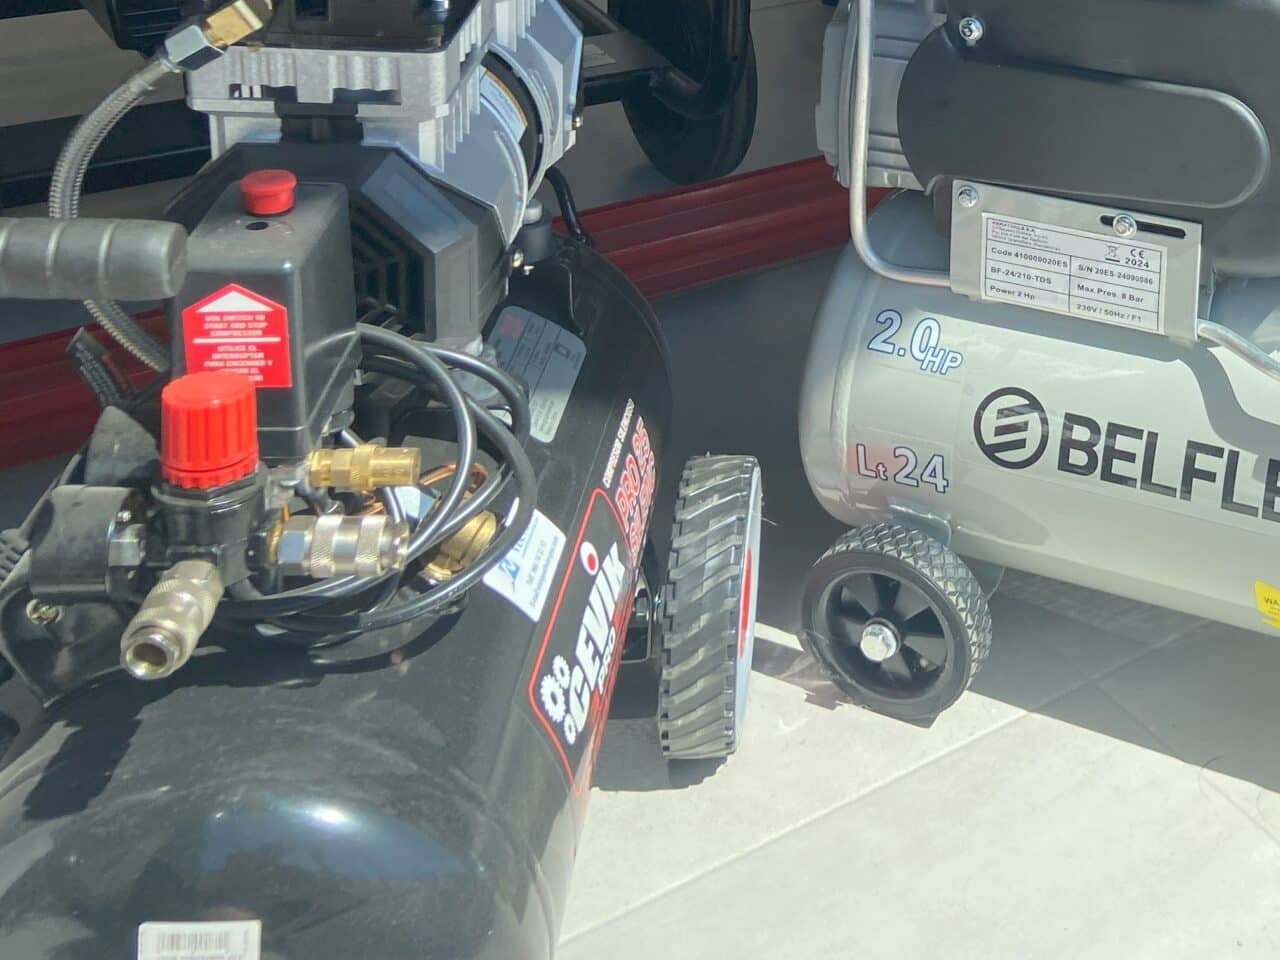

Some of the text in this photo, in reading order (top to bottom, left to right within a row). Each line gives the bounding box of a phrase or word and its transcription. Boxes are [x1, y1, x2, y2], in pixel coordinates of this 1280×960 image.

[991, 246, 1013, 258] Code
[1129, 248, 1145, 260] CE
[1077, 263, 1093, 274] S/N
[1124, 257, 1150, 269] 2024
[990, 284, 1015, 297] Power
[1077, 283, 1095, 294] Max
[1129, 292, 1145, 304] Bar
[1076, 303, 1098, 314] 230V
[1104, 308, 1126, 319] 50Hz
[892, 446, 950, 495] 24
[598, 625, 616, 695] PRO
